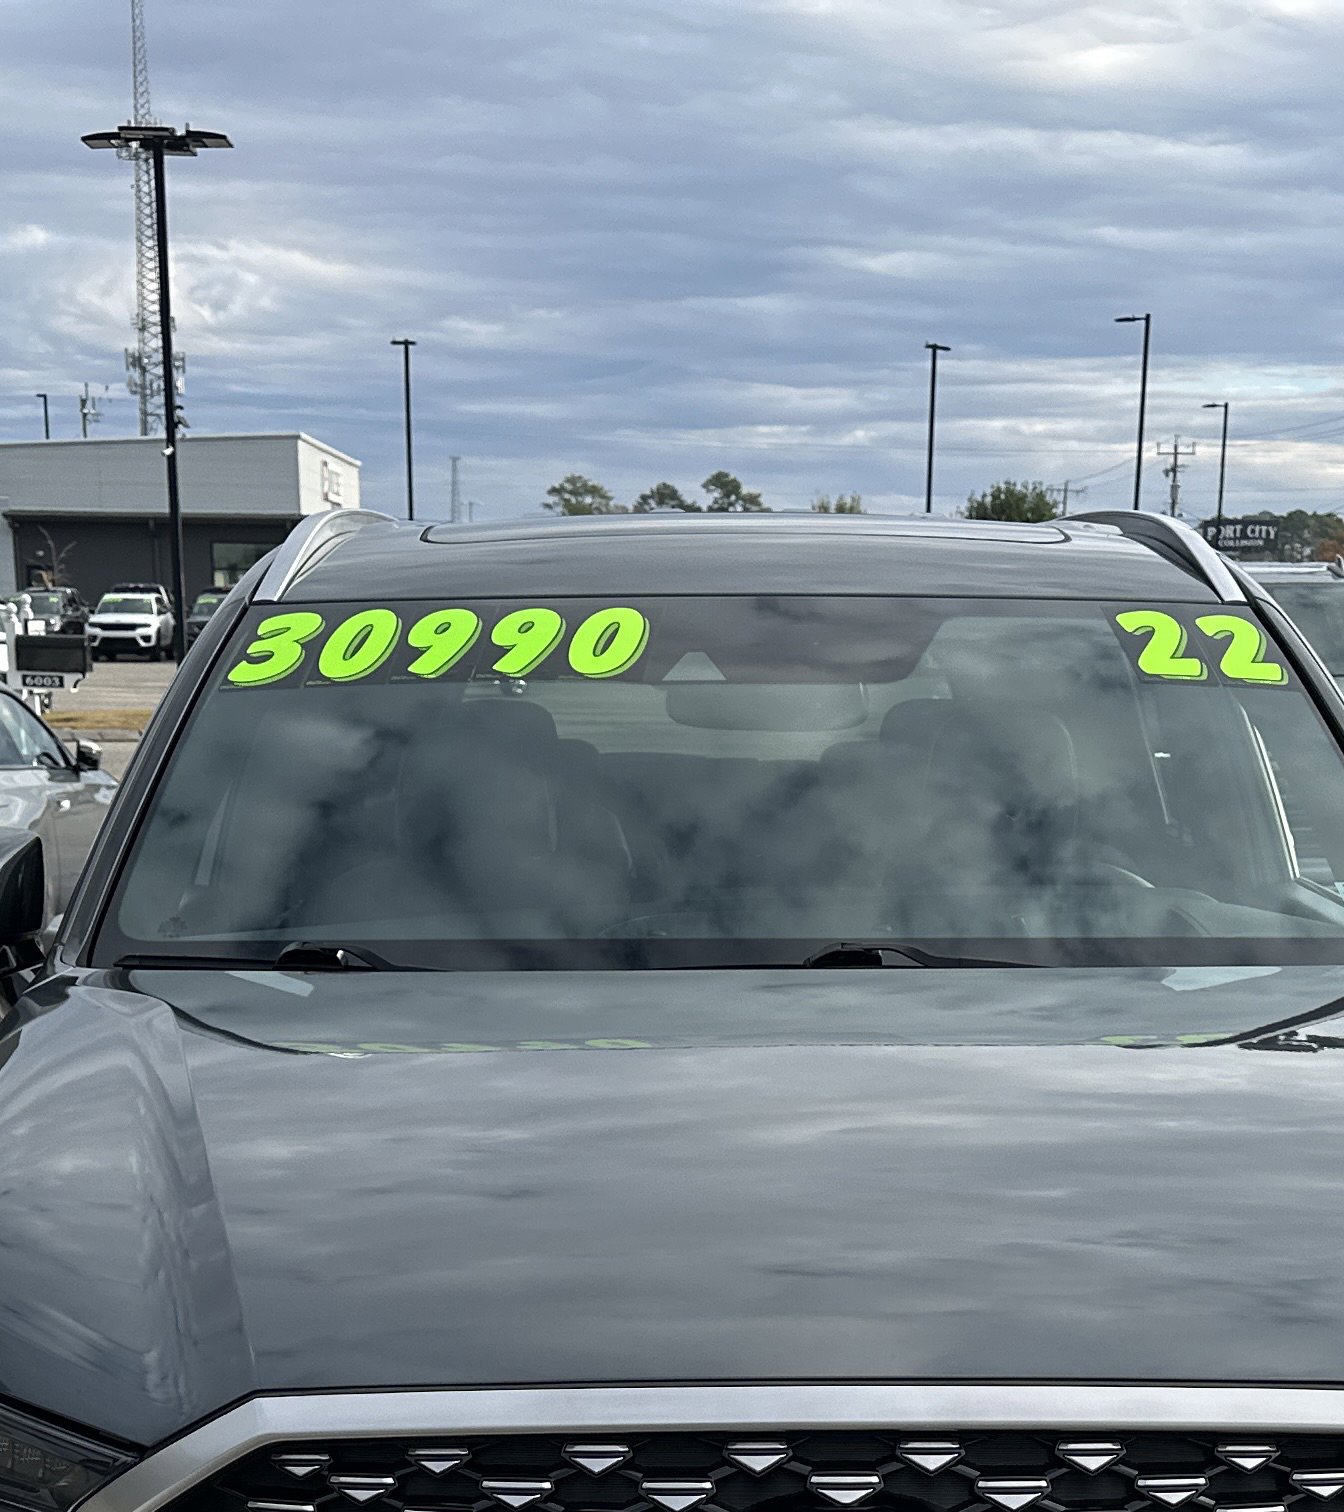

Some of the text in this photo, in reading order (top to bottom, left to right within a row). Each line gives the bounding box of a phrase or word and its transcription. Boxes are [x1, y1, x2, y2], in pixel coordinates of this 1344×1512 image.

[1246, 524, 1278, 540] CITY
[227, 607, 1289, 686] 30990 22
[25, 676, 61, 687] 6003
